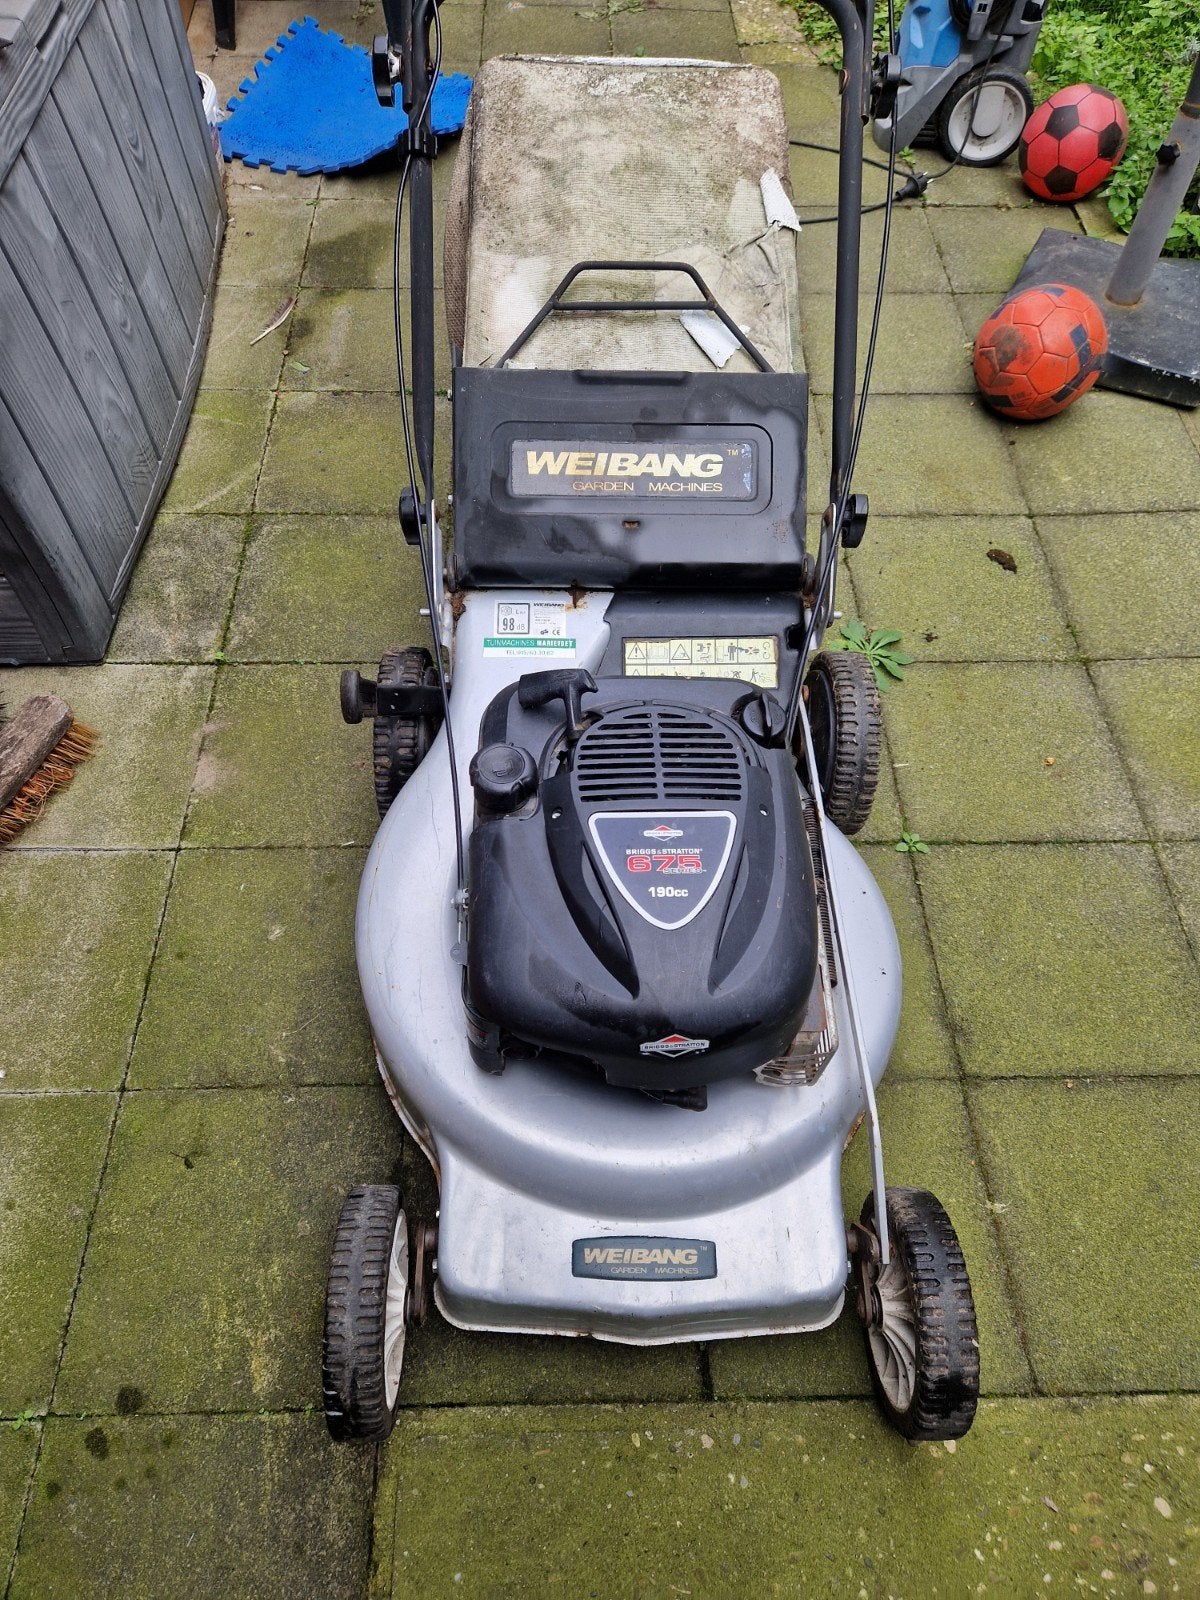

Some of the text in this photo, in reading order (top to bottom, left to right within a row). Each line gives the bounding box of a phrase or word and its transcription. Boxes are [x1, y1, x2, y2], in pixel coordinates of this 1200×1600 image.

[526, 450, 724, 478] WEIBANG
[572, 481, 723, 493] GARDEN MACHINES
[503, 617, 515, 631] 98
[627, 855, 702, 873] 675
[648, 886, 689, 898] 190cc
[584, 1247, 698, 1266] WEIBANG
[610, 1266, 699, 1275] GARDEN MACHINES
